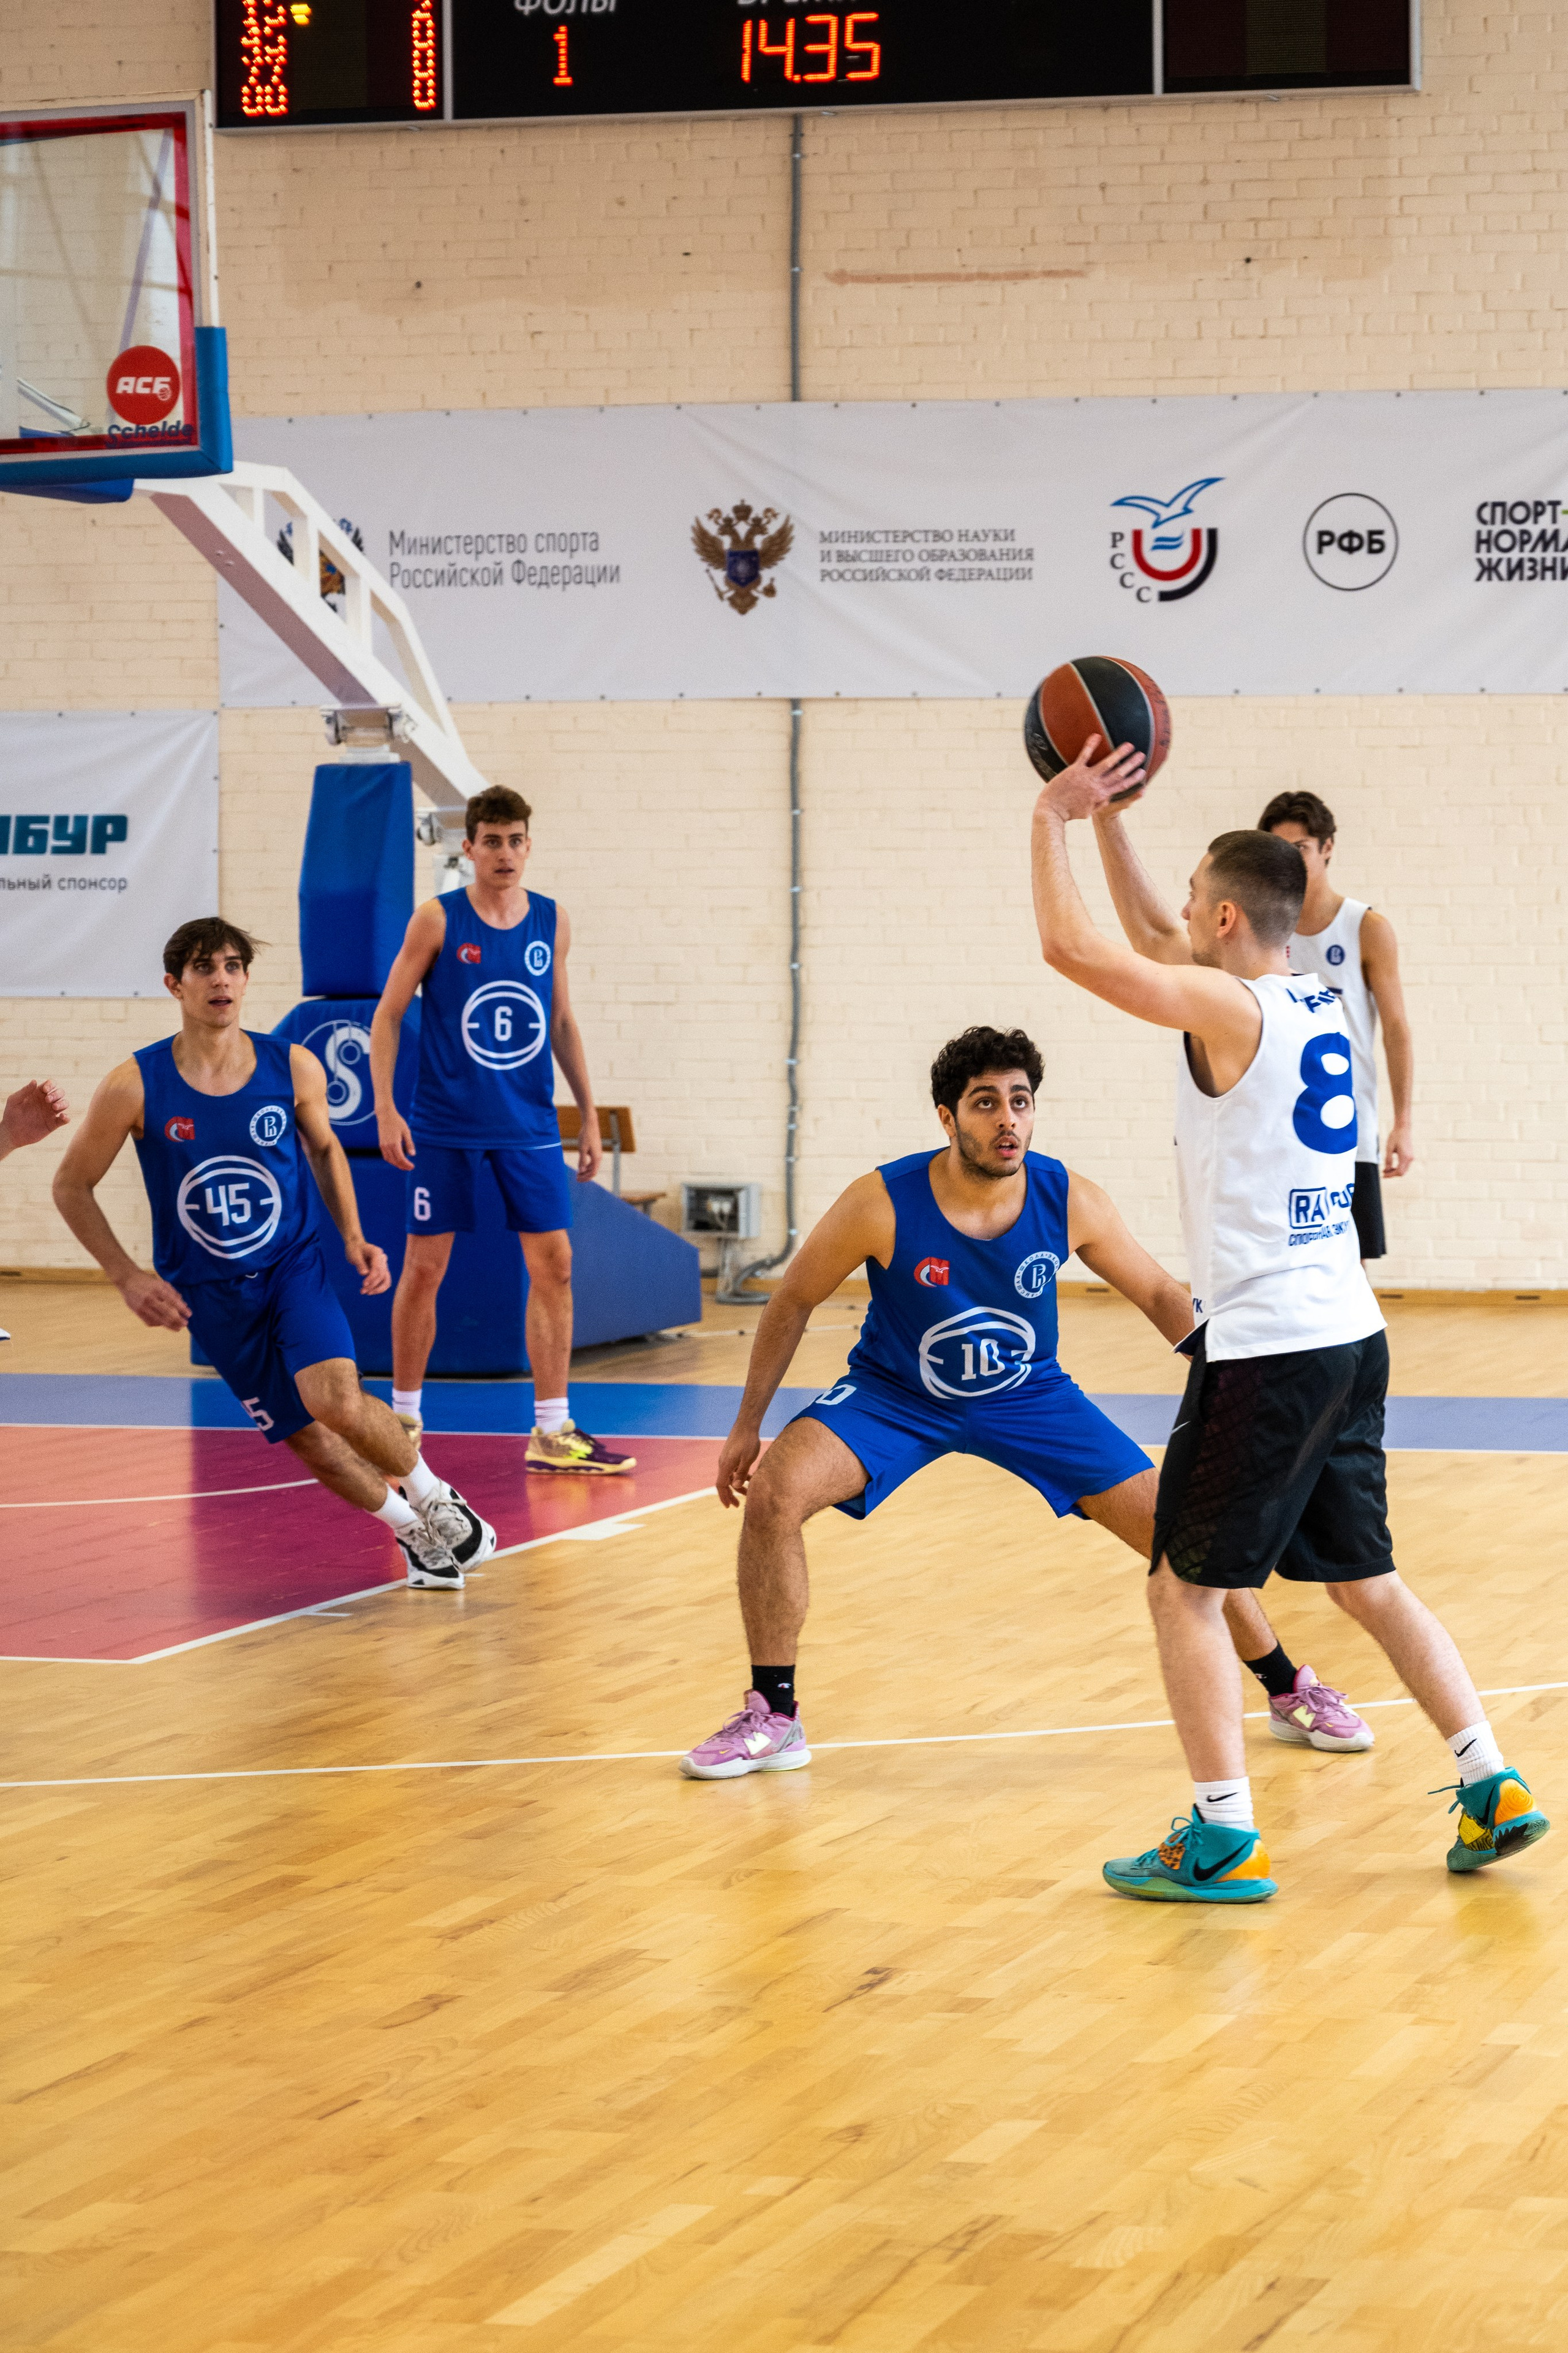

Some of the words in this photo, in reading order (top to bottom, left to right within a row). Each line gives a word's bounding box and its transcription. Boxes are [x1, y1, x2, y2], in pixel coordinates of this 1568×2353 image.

[552, 25, 573, 86] 1
[106, 420, 194, 448] Schelde
[389, 529, 527, 561] Министерство
[535, 531, 600, 558] спорта
[818, 529, 954, 544] МИНИСТЕРСТВО
[957, 529, 1016, 543] НАУКИ
[1316, 530, 1386, 555] РФБ
[820, 550, 832, 562] И
[836, 549, 915, 562] ВЫСШЕГО
[919, 548, 1034, 561] ОБРАЗОВАНИЯ
[389, 561, 503, 589] Российской
[511, 558, 620, 591] Федерации
[820, 566, 931, 583] РОССИЙСКОЙ
[935, 567, 1033, 583] ФЕДЕРАЦИИ
[58, 877, 128, 894] спонсор
[494, 1006, 513, 1041] 6
[1292, 1032, 1357, 1155] 8
[205, 1183, 252, 1226] 45
[413, 1187, 432, 1222] 6
[241, 1397, 274, 1431] 5
